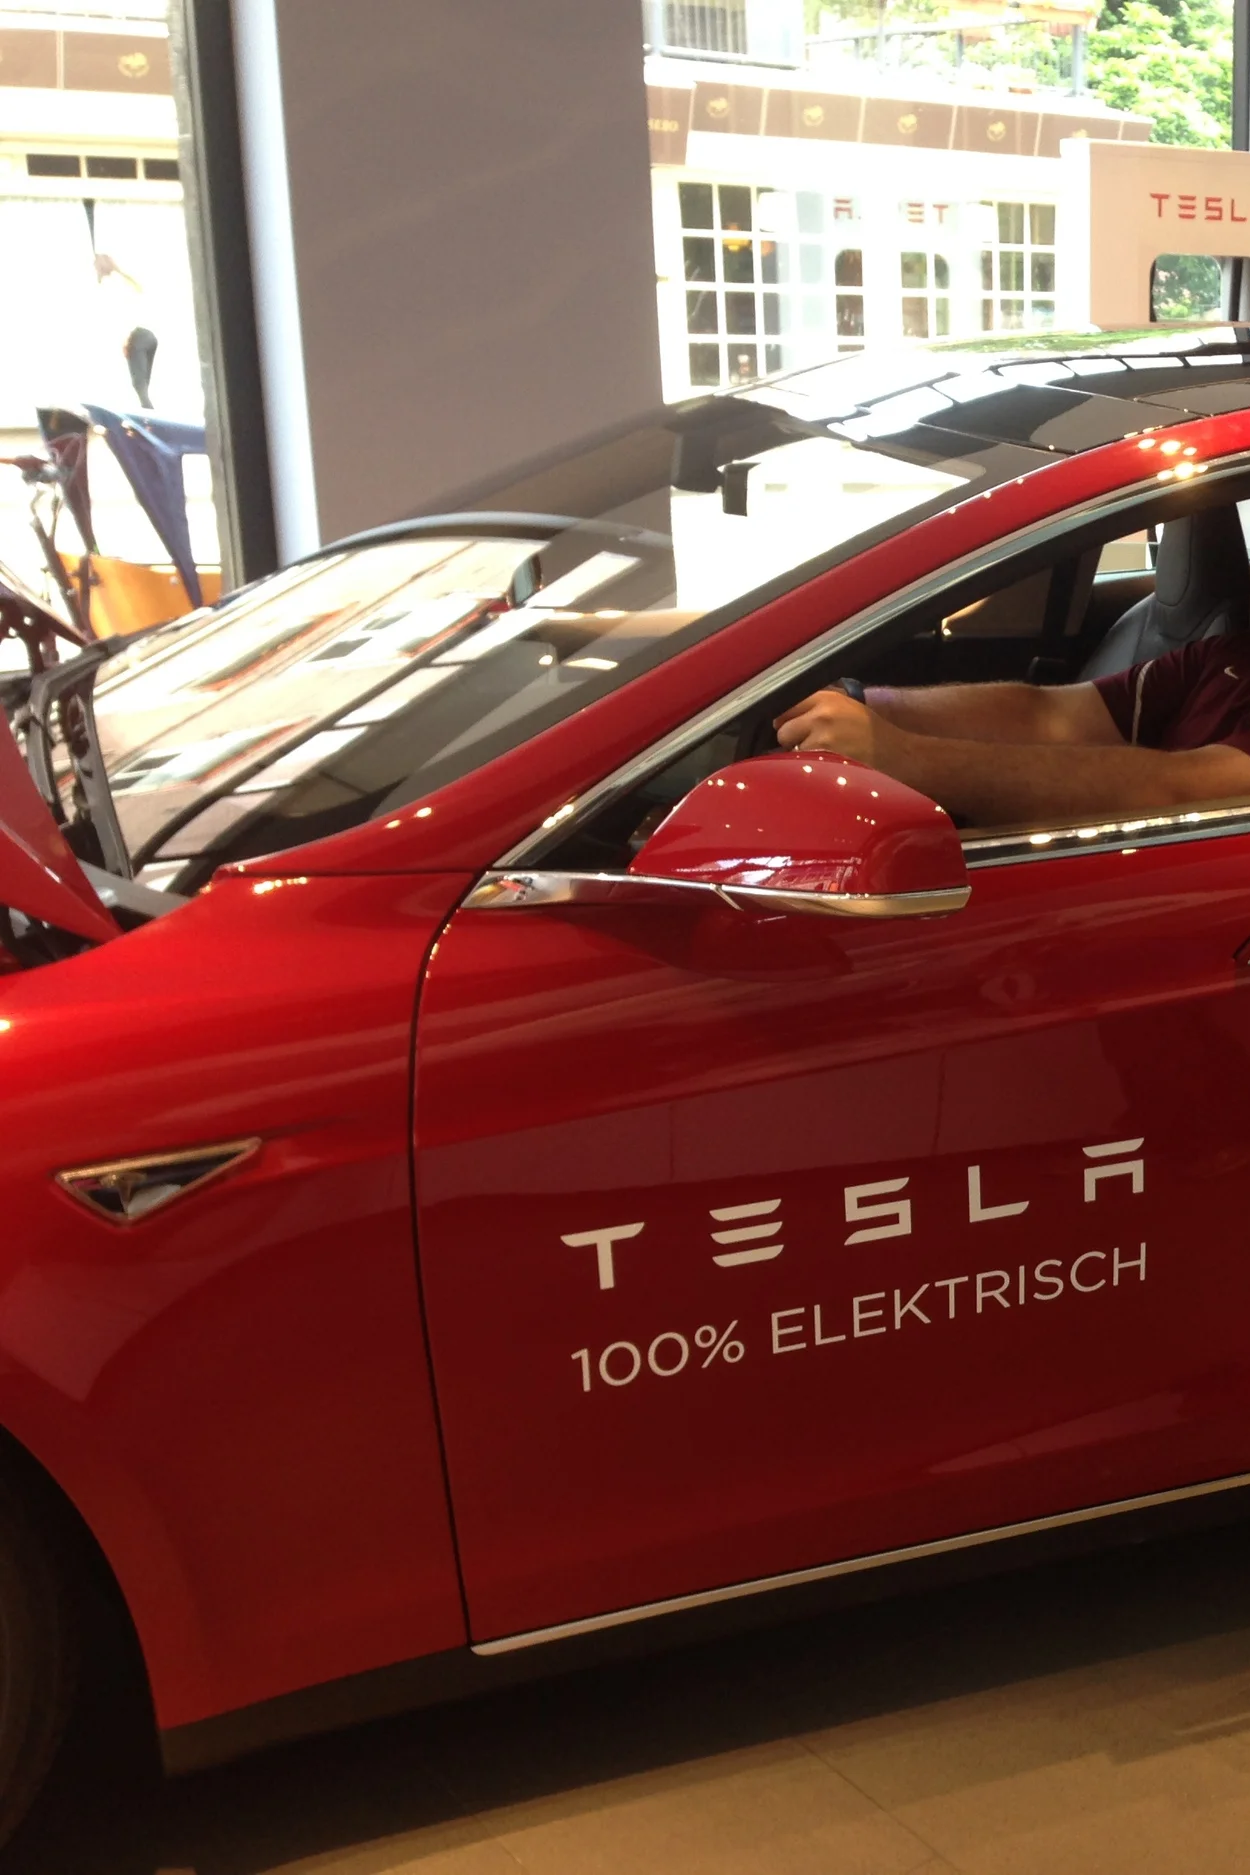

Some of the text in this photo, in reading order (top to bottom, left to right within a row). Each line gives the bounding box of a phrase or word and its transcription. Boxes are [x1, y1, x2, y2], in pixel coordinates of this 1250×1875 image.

[560, 1137, 1145, 1290] TESLA
[571, 1242, 1147, 1392] 100% ELEKTRISCH
